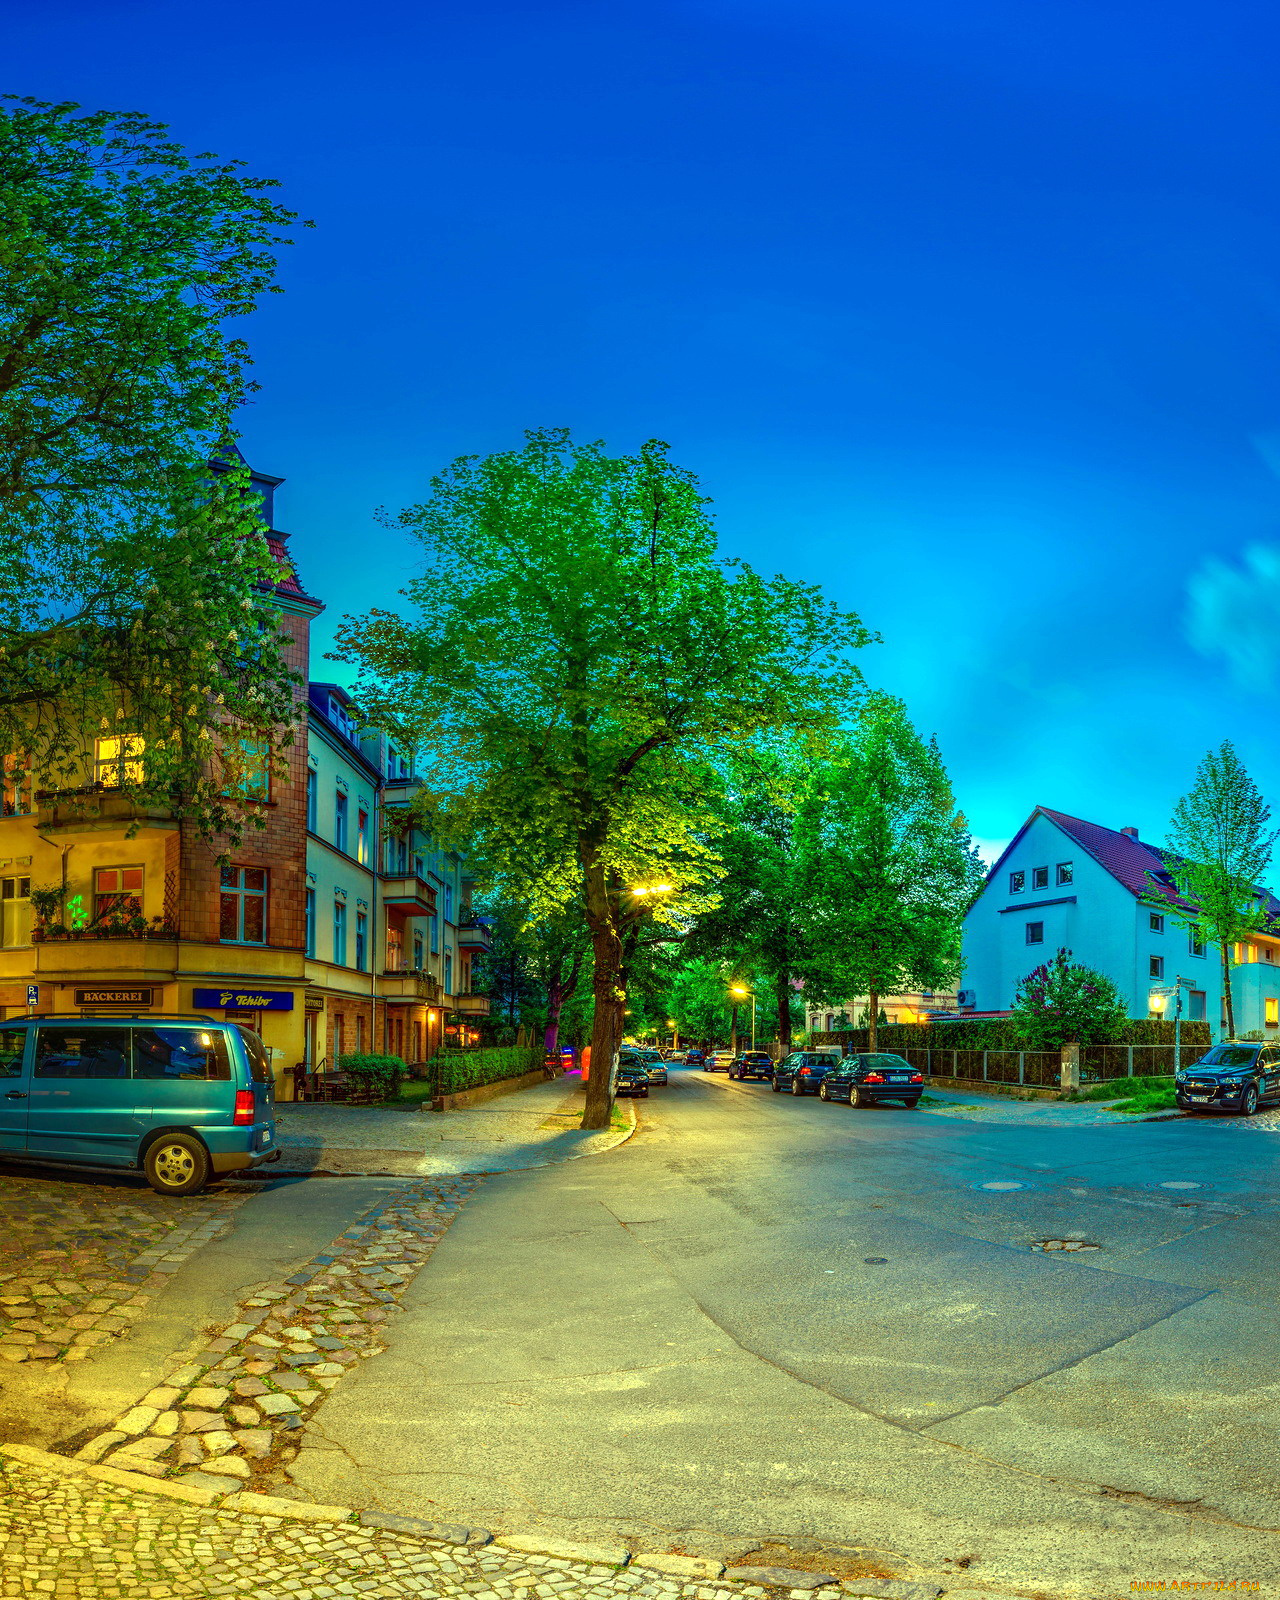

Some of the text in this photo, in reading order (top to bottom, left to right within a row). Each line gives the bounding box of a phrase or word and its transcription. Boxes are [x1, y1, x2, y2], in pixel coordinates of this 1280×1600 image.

[29, 986, 34, 994] P
[83, 992, 143, 1001] BÄCKEREI
[235, 995, 273, 1006] Tchibo
